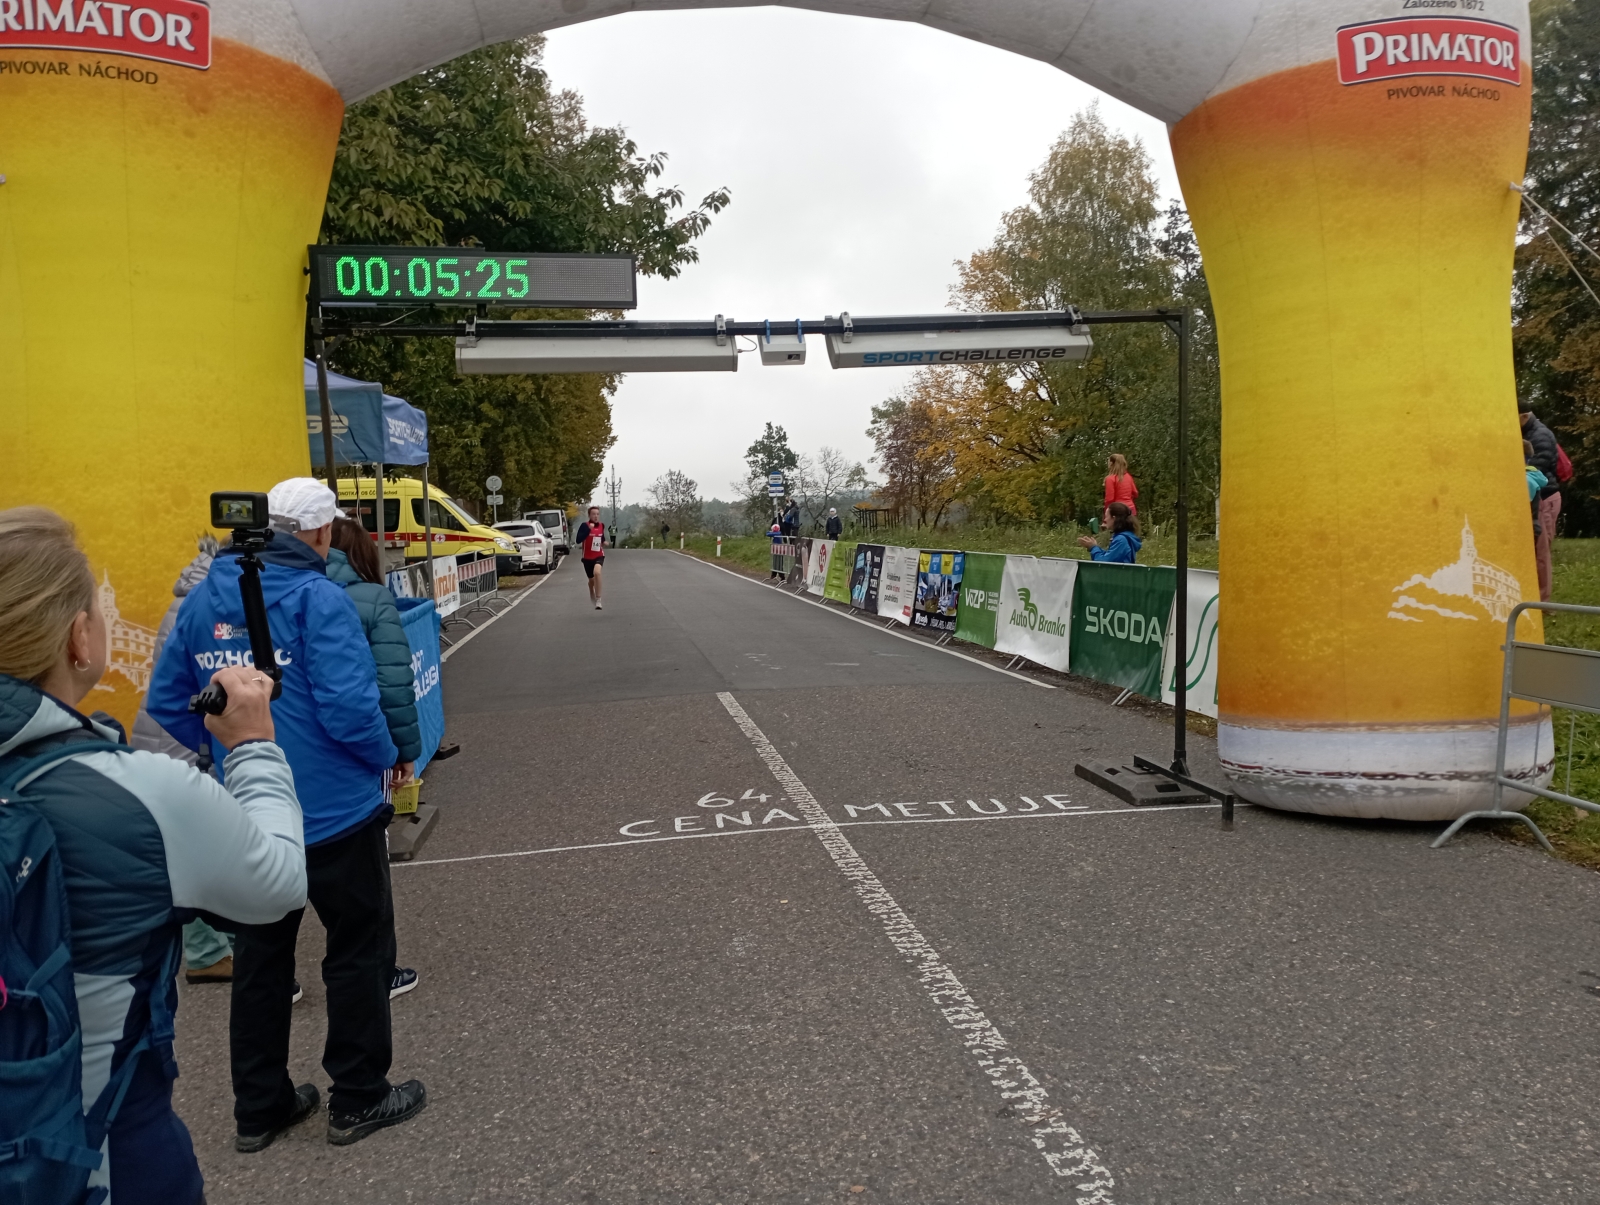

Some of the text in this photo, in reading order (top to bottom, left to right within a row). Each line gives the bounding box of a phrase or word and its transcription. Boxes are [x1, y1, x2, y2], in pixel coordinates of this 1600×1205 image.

[1460, 0, 1485, 11] 1872
[1351, 31, 1516, 74] PRIMÁTOR
[0, 60, 158, 85] PIVOVAR NÁCHOD
[1387, 84, 1500, 101] PIVOVAR NÁCHOD
[335, 256, 528, 298] 00:05:25
[1009, 609, 1066, 637] Auto Branka
[619, 793, 1089, 837] CENA METUJE
